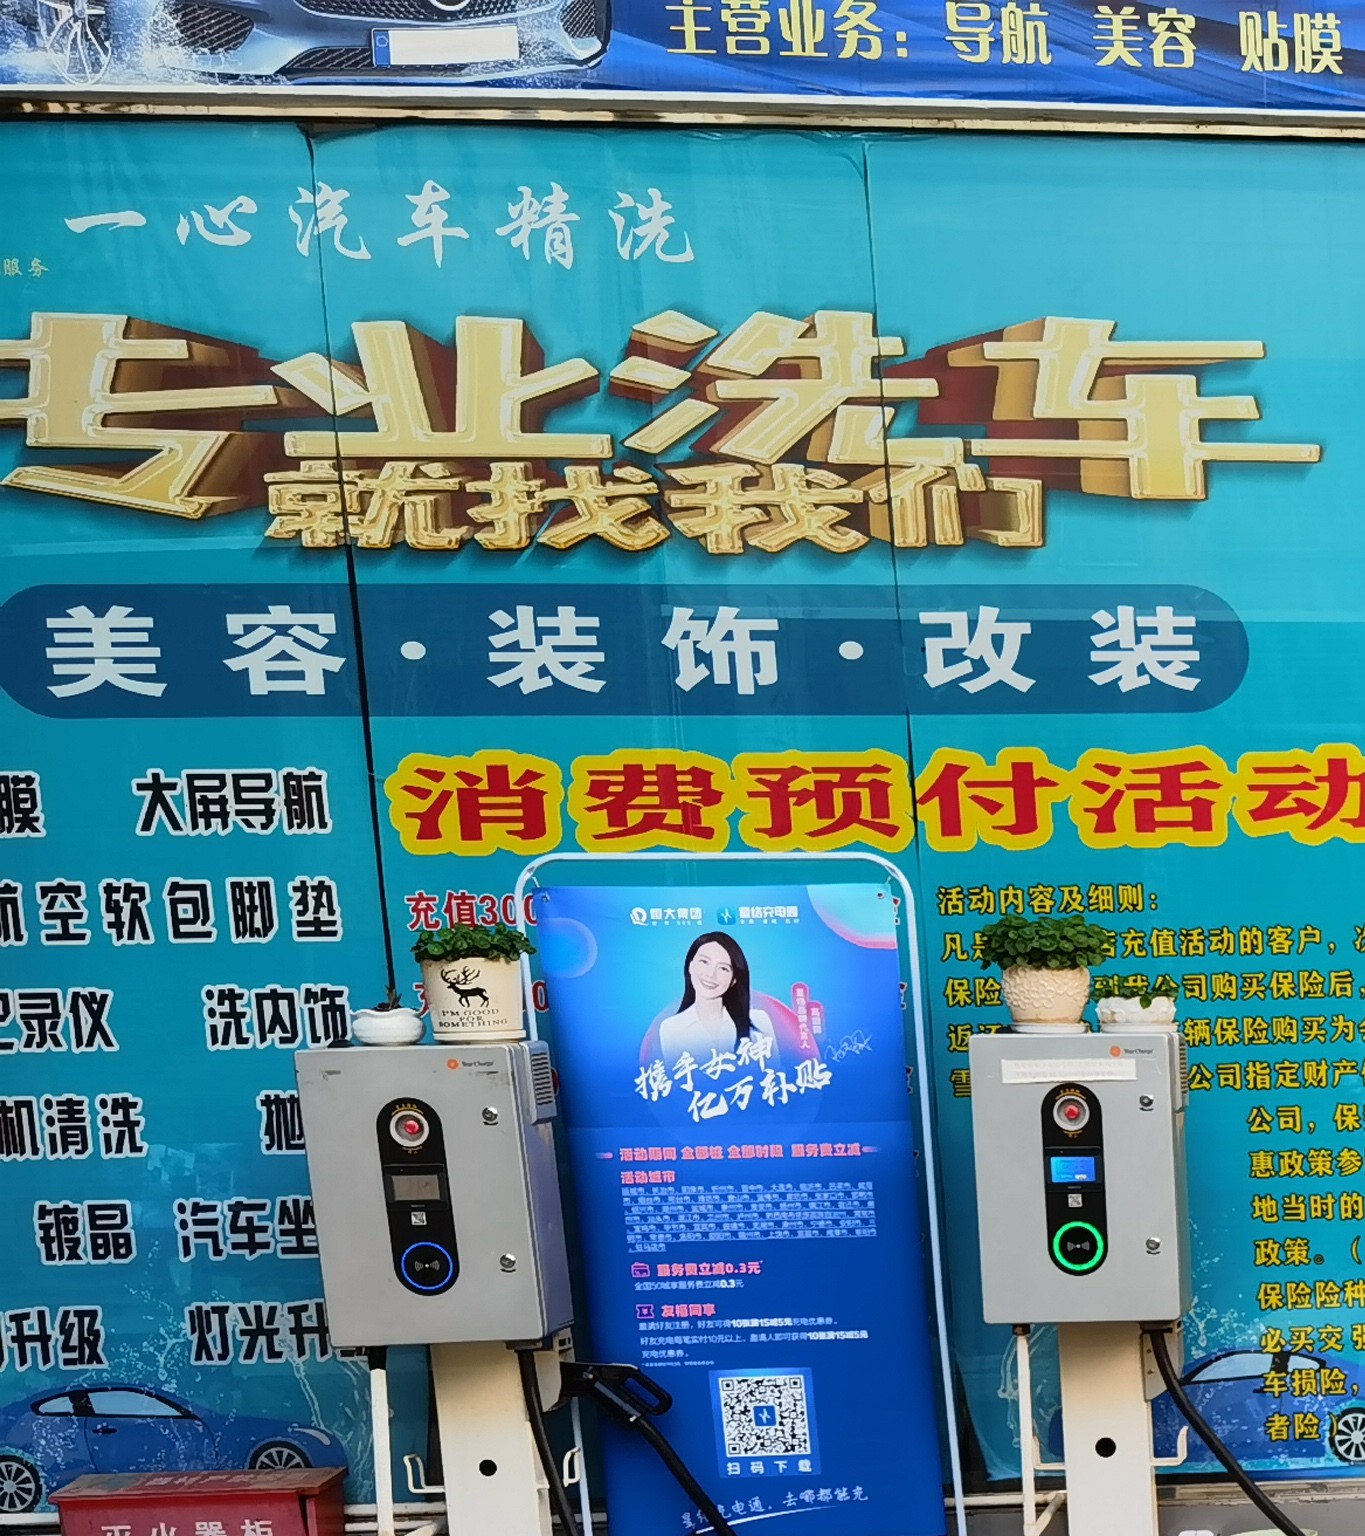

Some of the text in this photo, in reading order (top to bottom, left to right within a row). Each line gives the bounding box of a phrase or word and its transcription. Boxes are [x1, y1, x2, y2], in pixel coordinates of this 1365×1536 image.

[1094, 5, 1196, 69] 美容
[1239, 11, 1343, 74] 贴膜
[63, 179, 696, 268] 一心汽车精洗
[0, 309, 1322, 519] 专业洗车
[265, 460, 1043, 553] 就找我们
[135, 770, 331, 834] 大屏导航
[937, 884, 1159, 915] 活动内容及细则：
[205, 986, 349, 1047] 洗内饰
[688, 1058, 833, 1123] 亿万补贴
[37, 1203, 135, 1262] 镀晶
